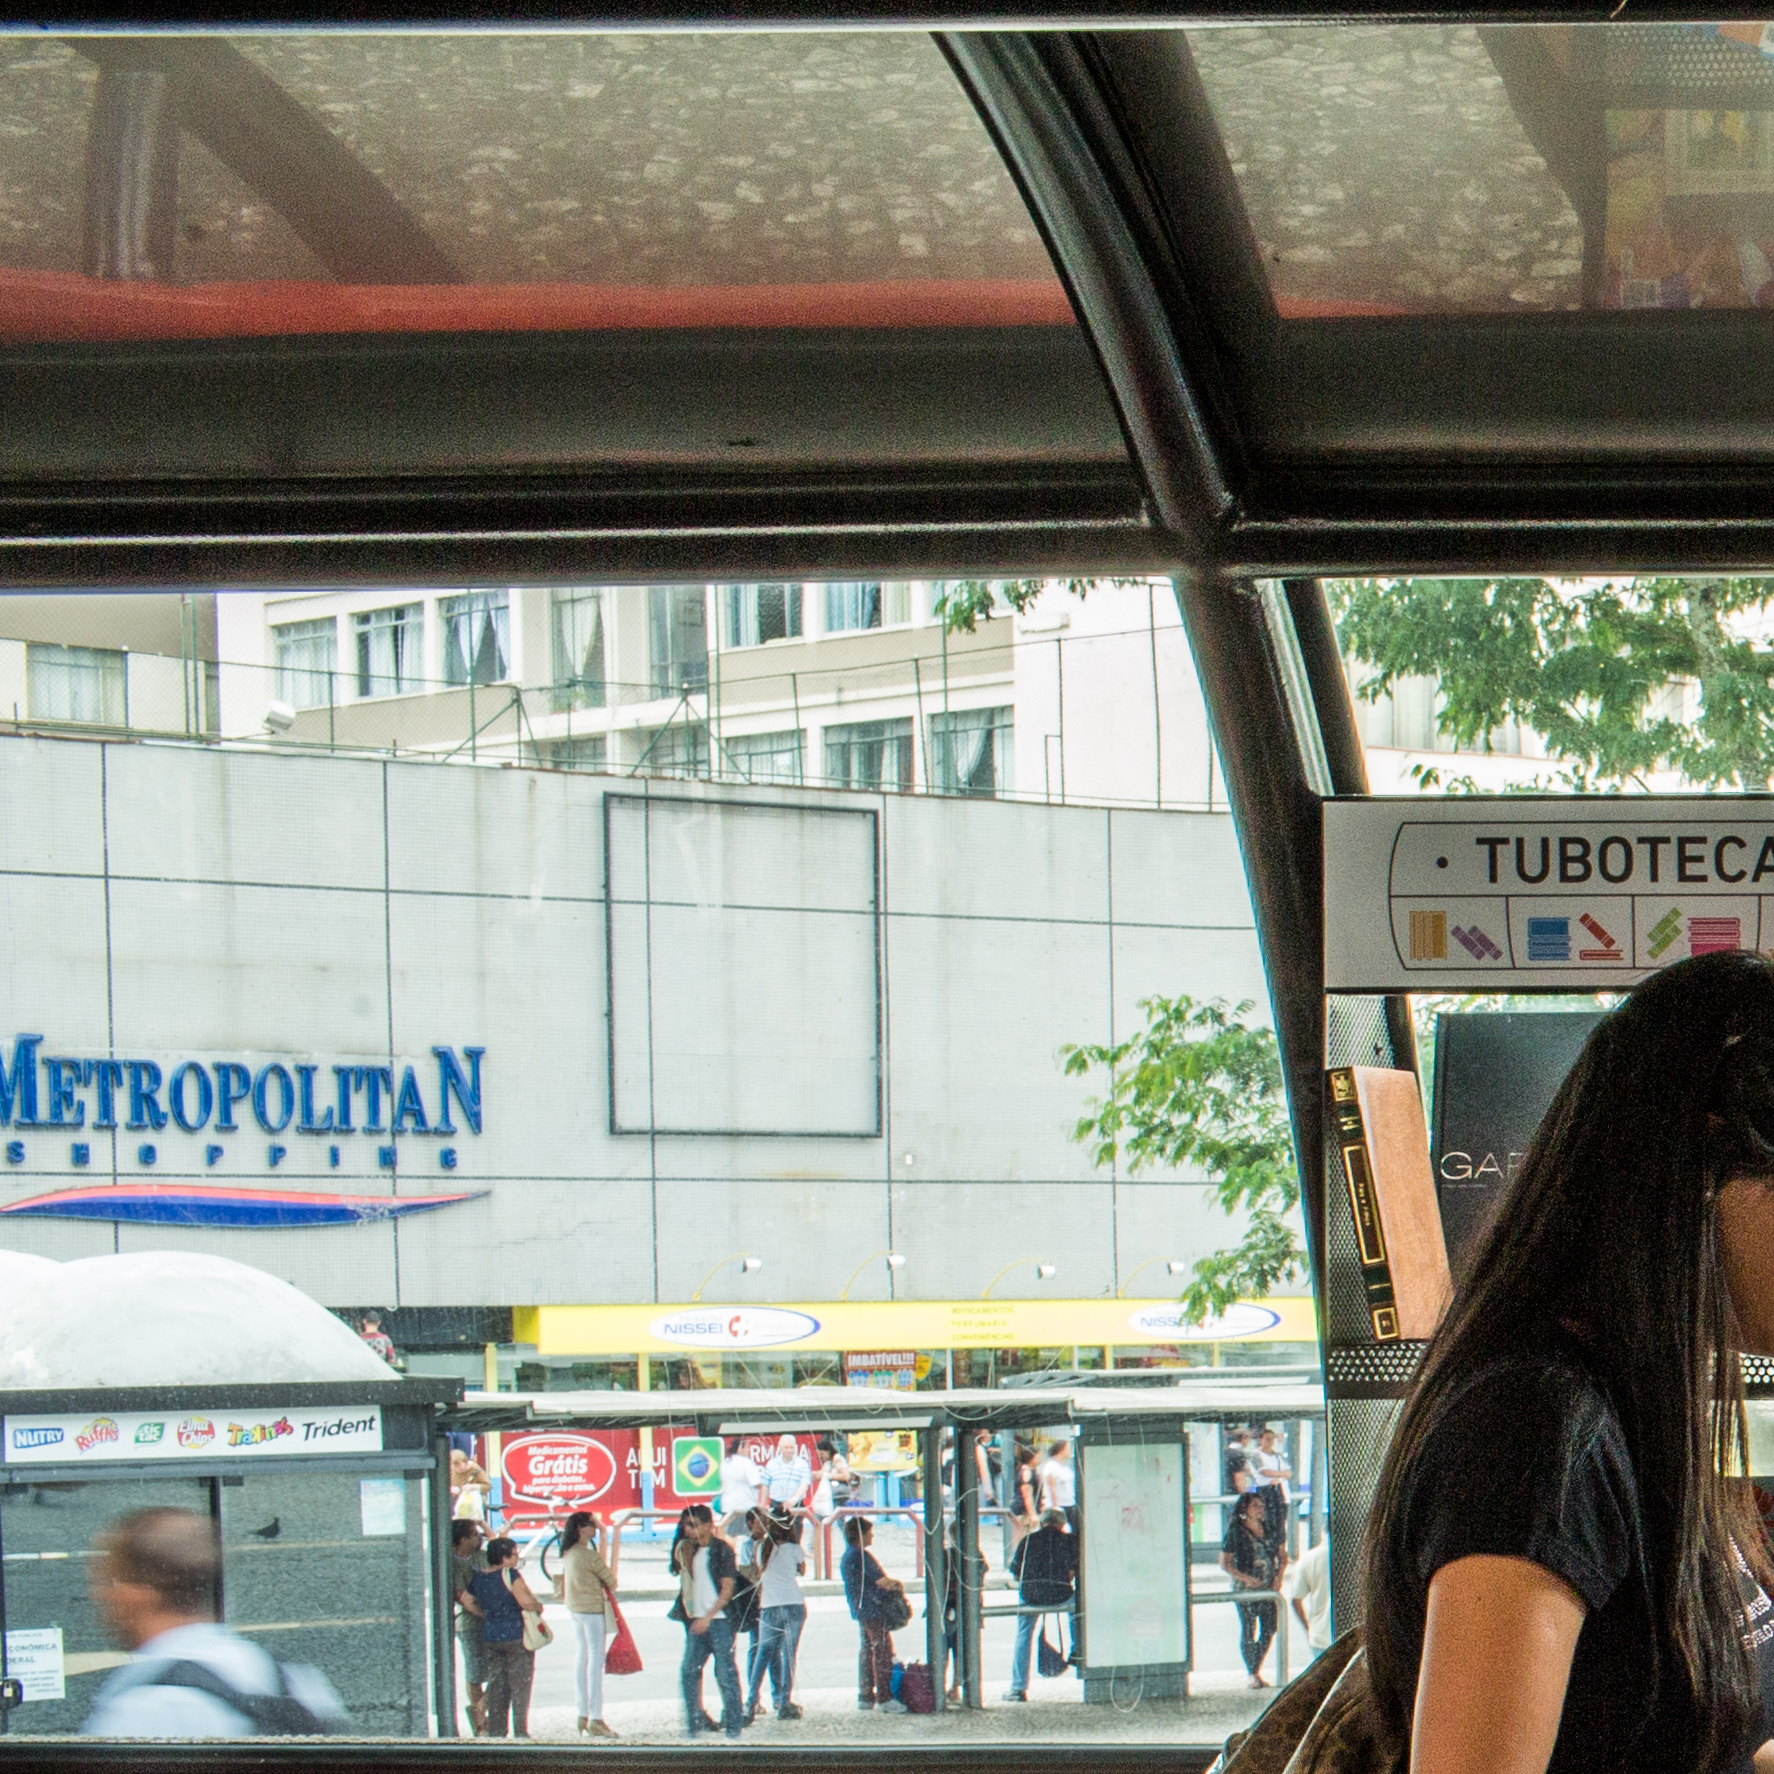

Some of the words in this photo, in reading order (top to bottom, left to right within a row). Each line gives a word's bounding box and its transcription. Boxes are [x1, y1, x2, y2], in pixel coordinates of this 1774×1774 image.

[0, 1033, 486, 1136] METROPOLITAN
[6, 1141, 457, 1169] SHOPPING
[664, 1323, 723, 1334] NISSEI
[848, 1351, 915, 1367] IMBATÍVEL!!!
[75, 1424, 121, 1452] Ruffles
[180, 1429, 216, 1445] Chips
[227, 1416, 294, 1447] Trakinas
[302, 1415, 376, 1441] Trident
[14, 1429, 63, 1448] NUTRY
[528, 1455, 588, 1475] Grátis
[626, 1446, 667, 1467] AUI
[627, 1468, 666, 1488] TM
[8, 1643, 58, 1653] CONÔMICA
